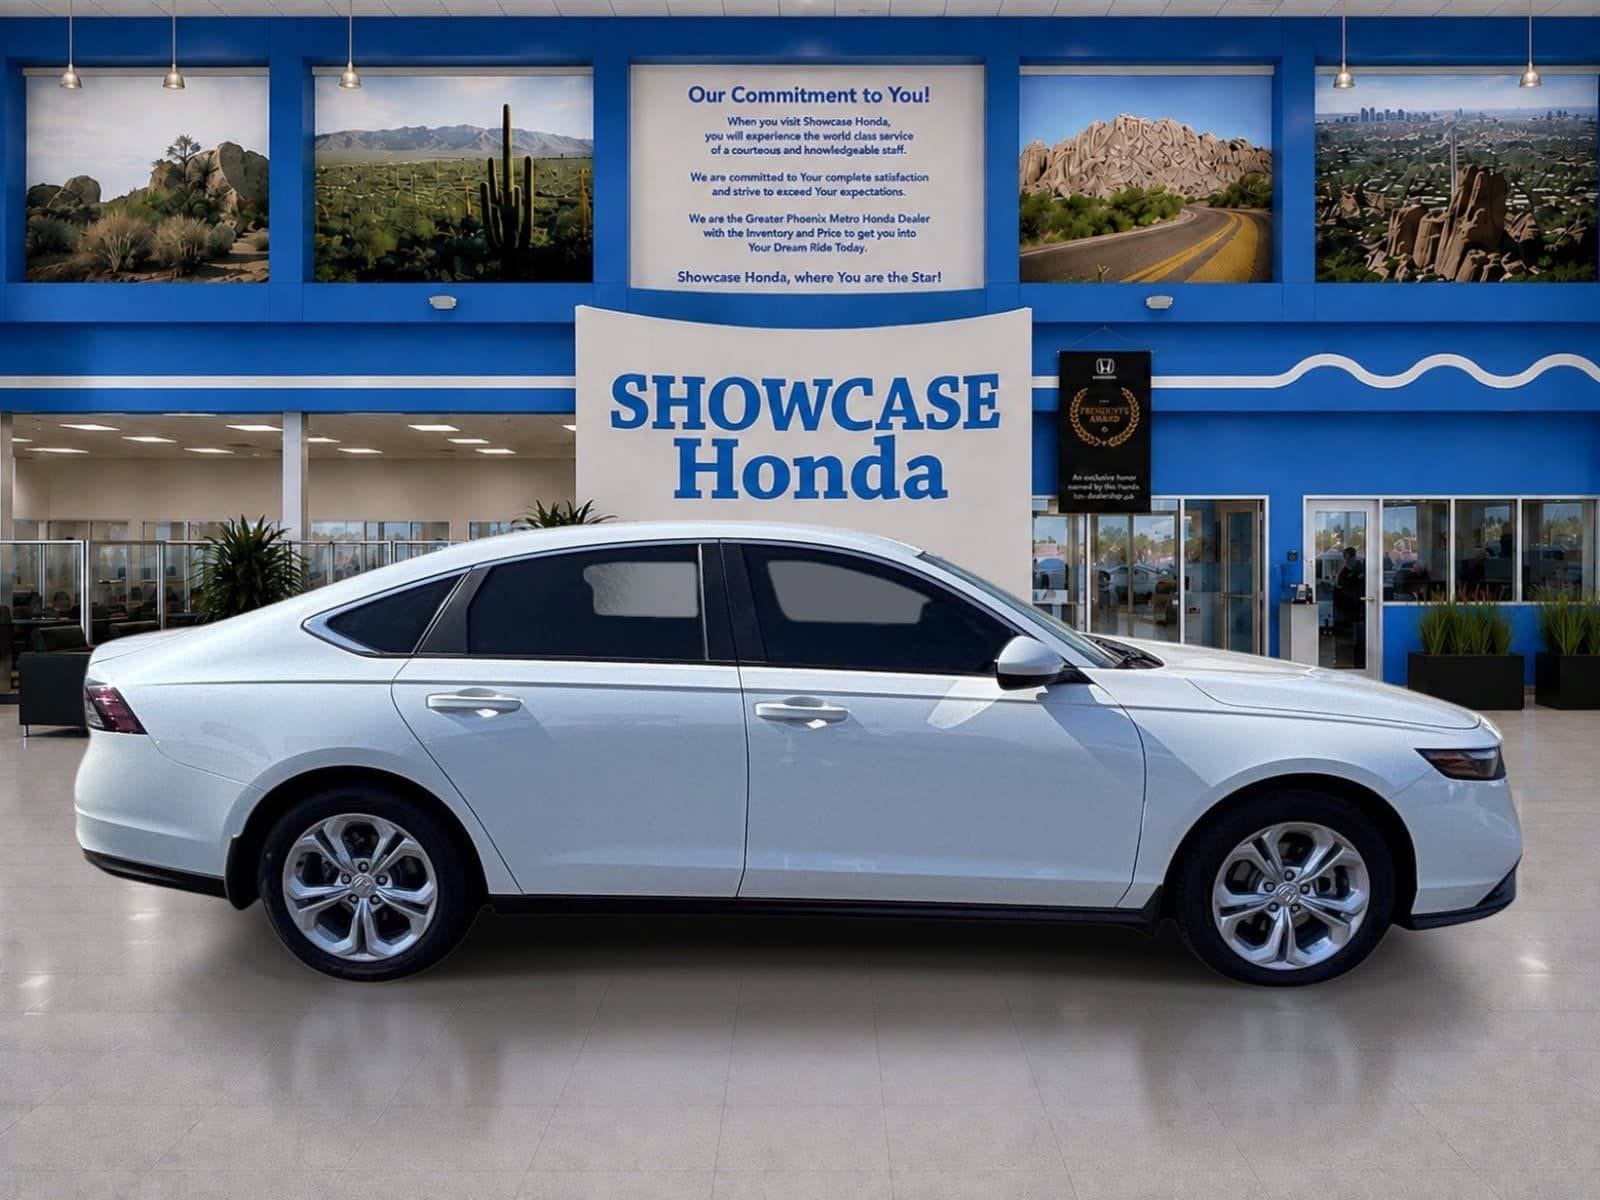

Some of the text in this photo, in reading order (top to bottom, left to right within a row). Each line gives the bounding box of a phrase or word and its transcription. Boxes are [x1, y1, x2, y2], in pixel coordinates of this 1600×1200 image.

[687, 85, 930, 104] Our Commitment to You!
[727, 116, 891, 129] When you visit Showcase Honda,
[704, 130, 914, 143] you will experience the world class service
[710, 144, 722, 155] of
[722, 147, 730, 155] a
[730, 146, 782, 155] courteous
[783, 144, 802, 155] and
[881, 144, 907, 155] staff.
[690, 171, 929, 185] We are committed to Your complete satisfaction
[711, 185, 906, 200] and strive to exceed Your expectations.
[688, 213, 931, 224] We are the Greater Phoenix Metro Honda Dealer
[702, 227, 917, 241] with the Inventory and Price to get you into
[748, 242, 868, 255] Your Dream Ride Today.
[677, 270, 942, 285] Showcase Honda, where You are the Star!
[611, 373, 1000, 431] SHOWCASE
[674, 434, 948, 499] Honda
